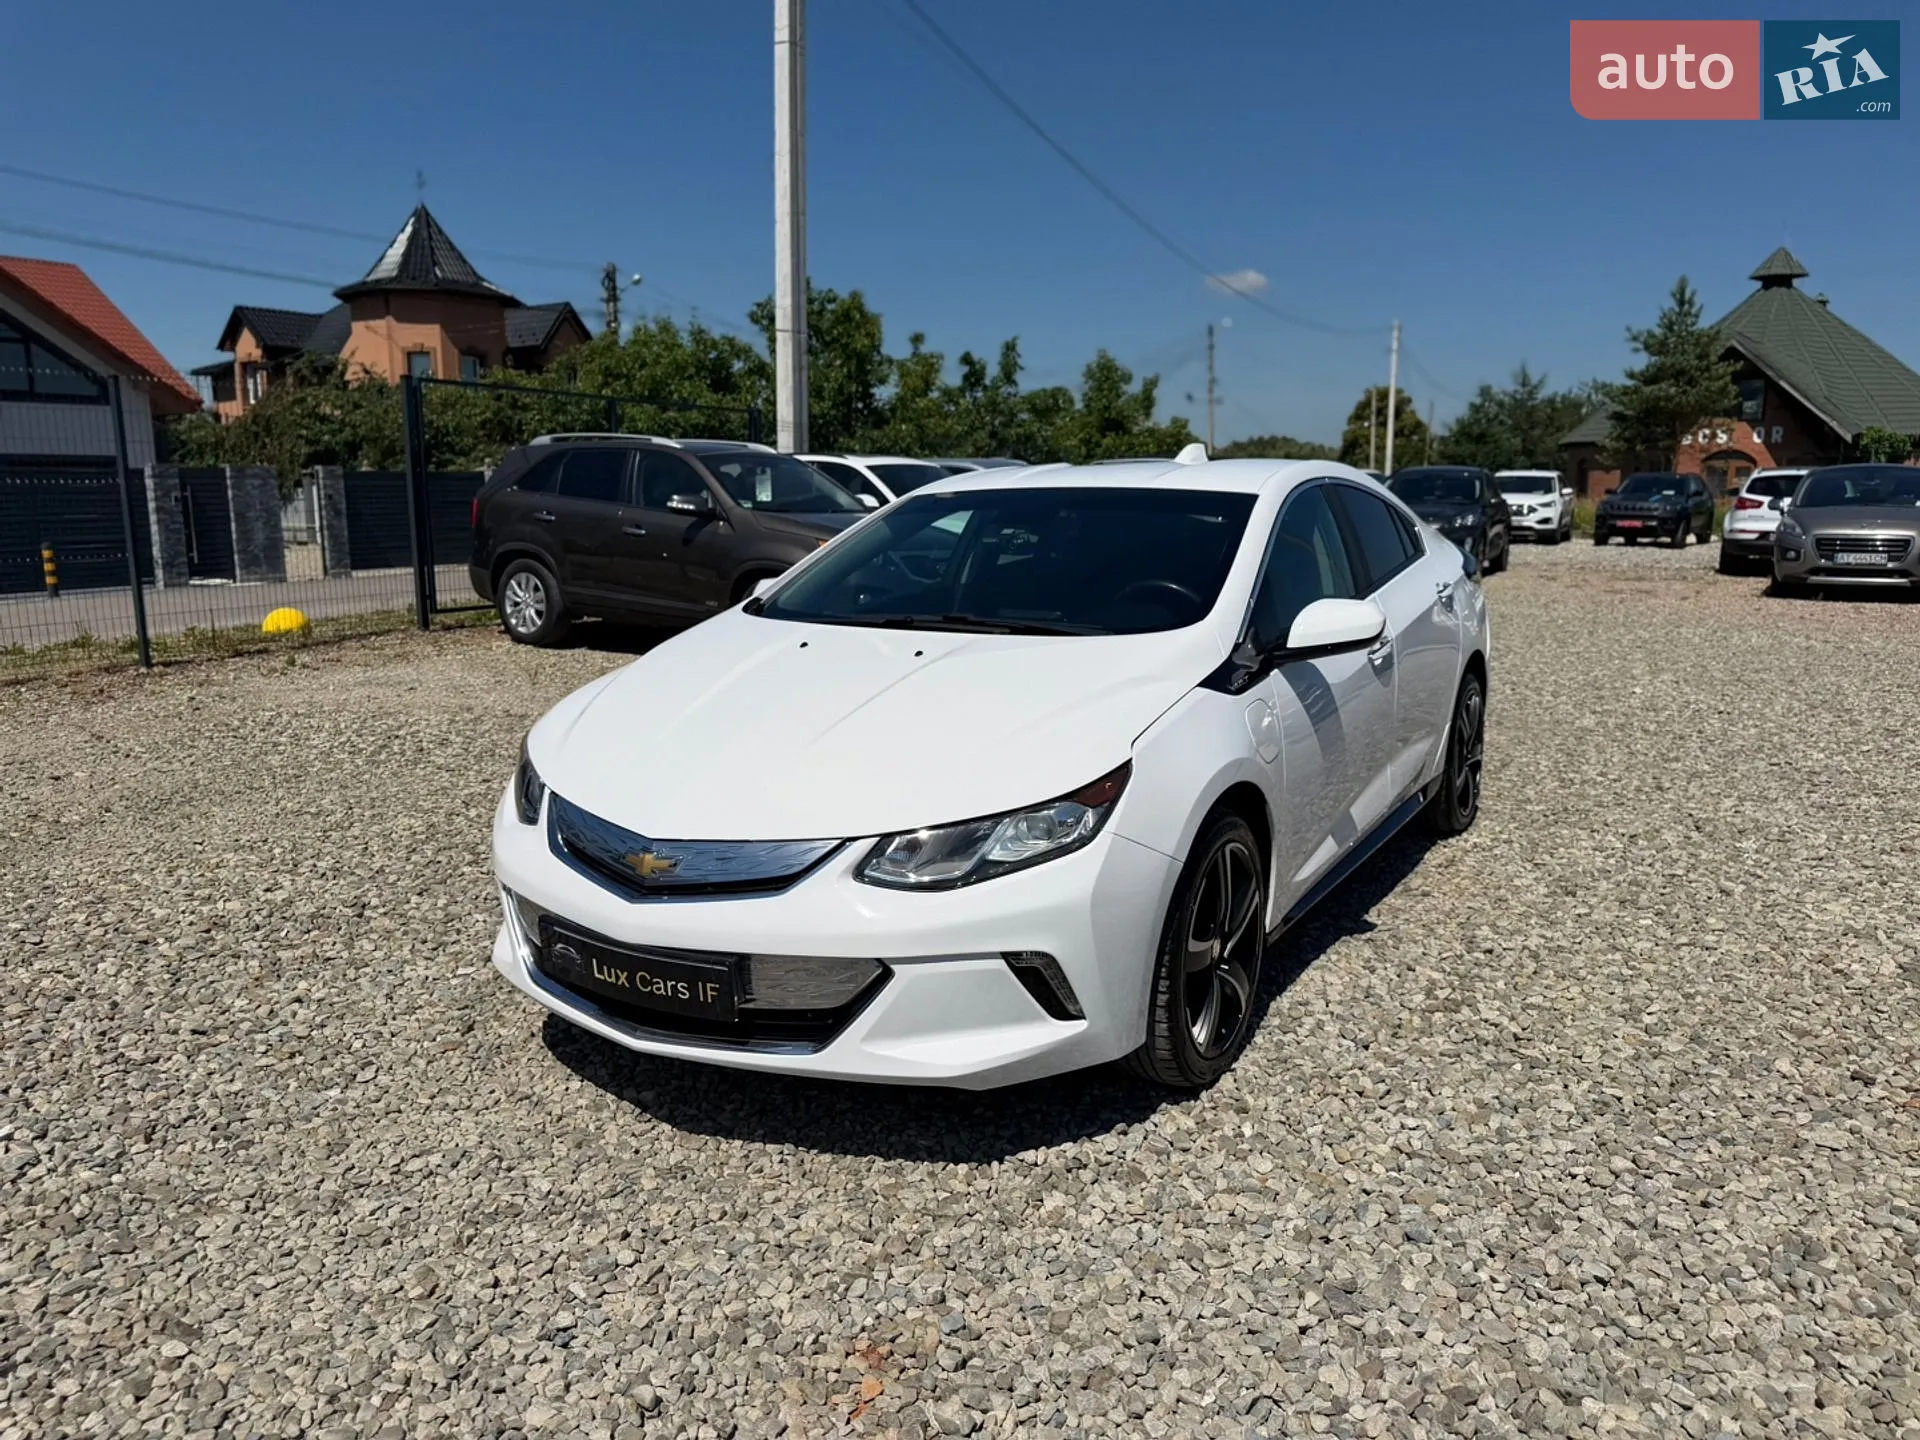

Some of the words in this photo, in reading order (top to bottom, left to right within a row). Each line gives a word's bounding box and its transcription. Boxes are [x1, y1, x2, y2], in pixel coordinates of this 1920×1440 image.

[591, 958, 630, 988] Lux
[635, 971, 690, 1000] Cars
[697, 981, 720, 1004] IF
